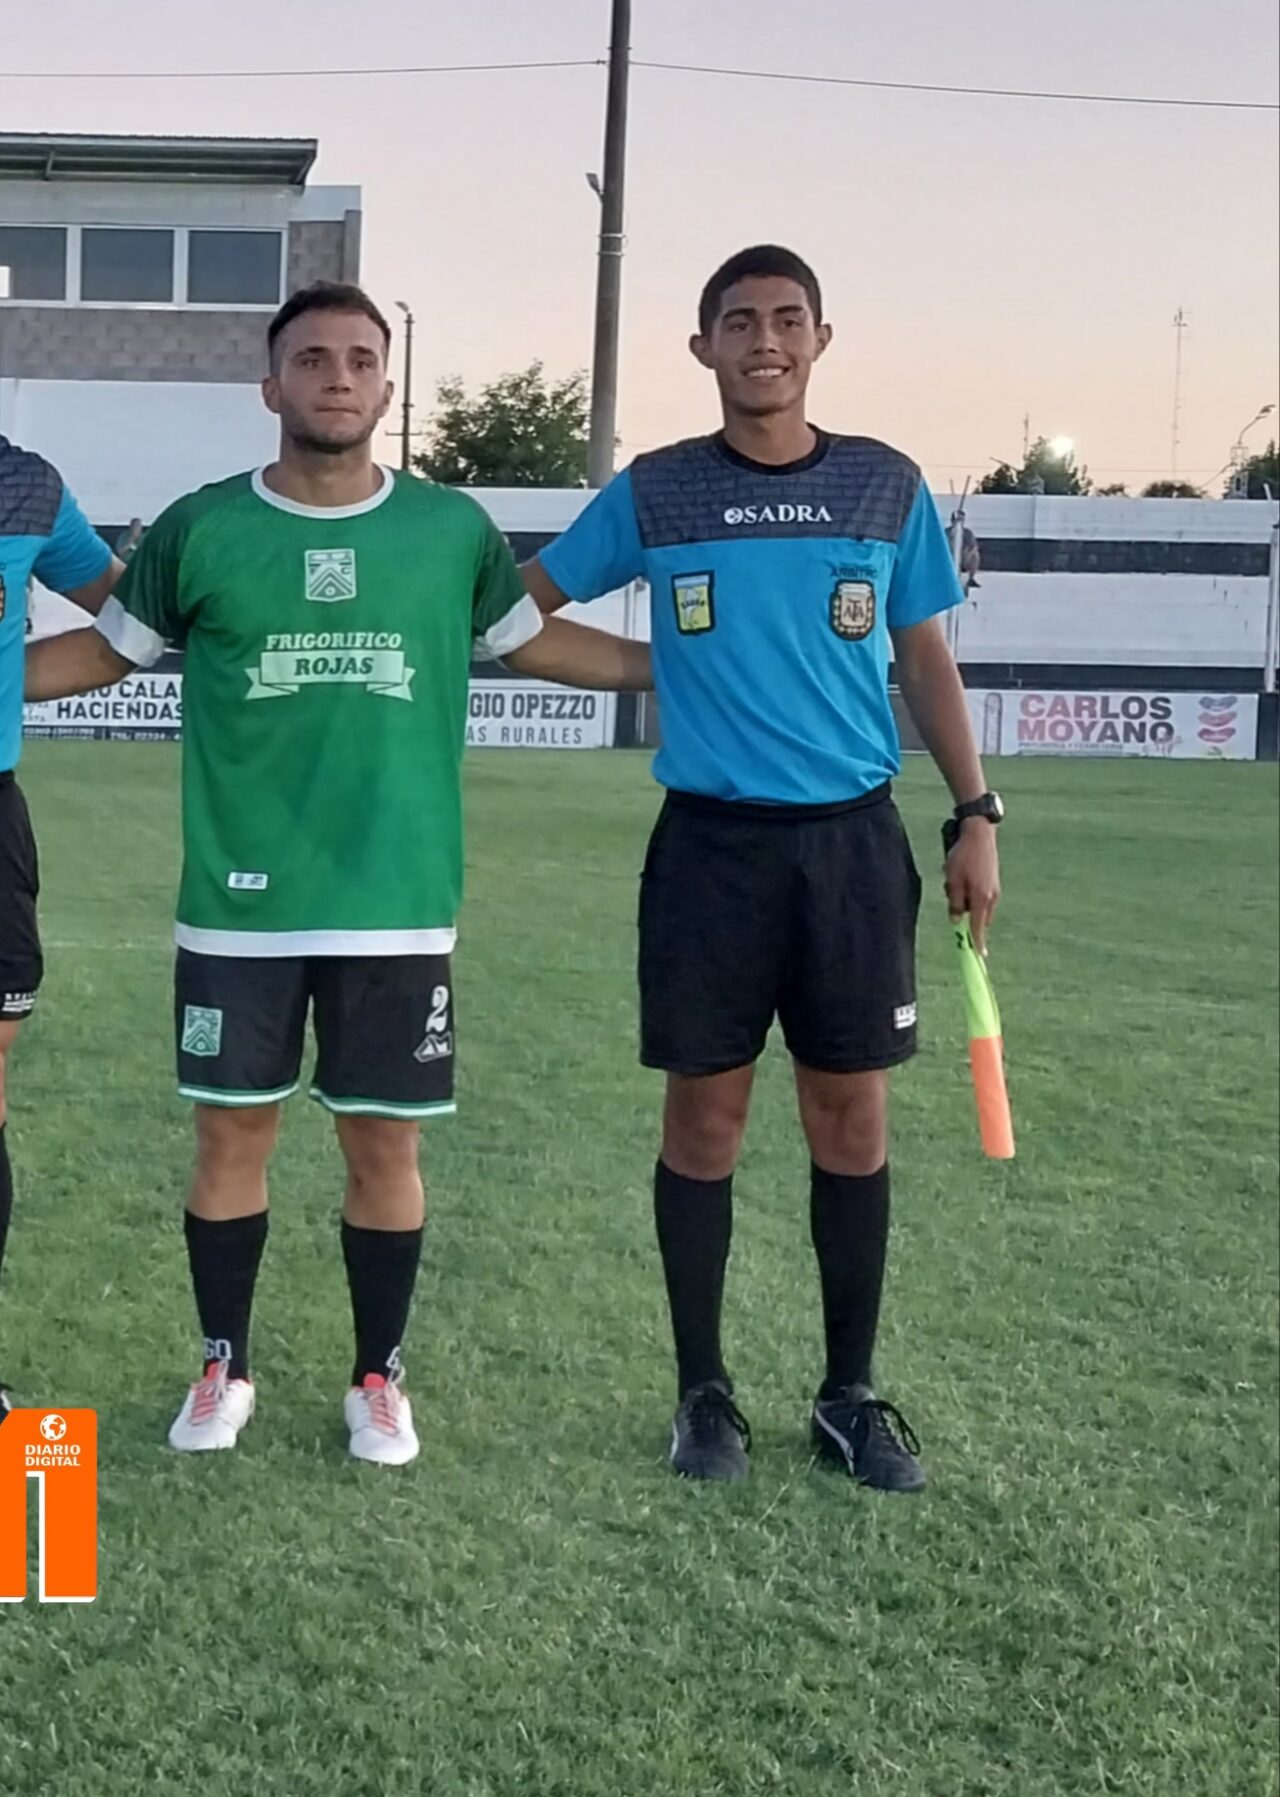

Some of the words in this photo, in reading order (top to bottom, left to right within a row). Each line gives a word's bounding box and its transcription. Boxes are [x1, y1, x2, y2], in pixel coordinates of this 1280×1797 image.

[743, 504, 832, 524] SADRA
[266, 632, 403, 650] FRIGORIFICO
[294, 657, 374, 676] ROJAS
[120, 681, 178, 699] CALA
[511, 694, 596, 719] OPEZZO
[1020, 694, 1173, 719] CARLOS
[501, 726, 583, 744] RURALES
[1017, 718, 1175, 744] MOYANO
[425, 985, 449, 1032] 2
